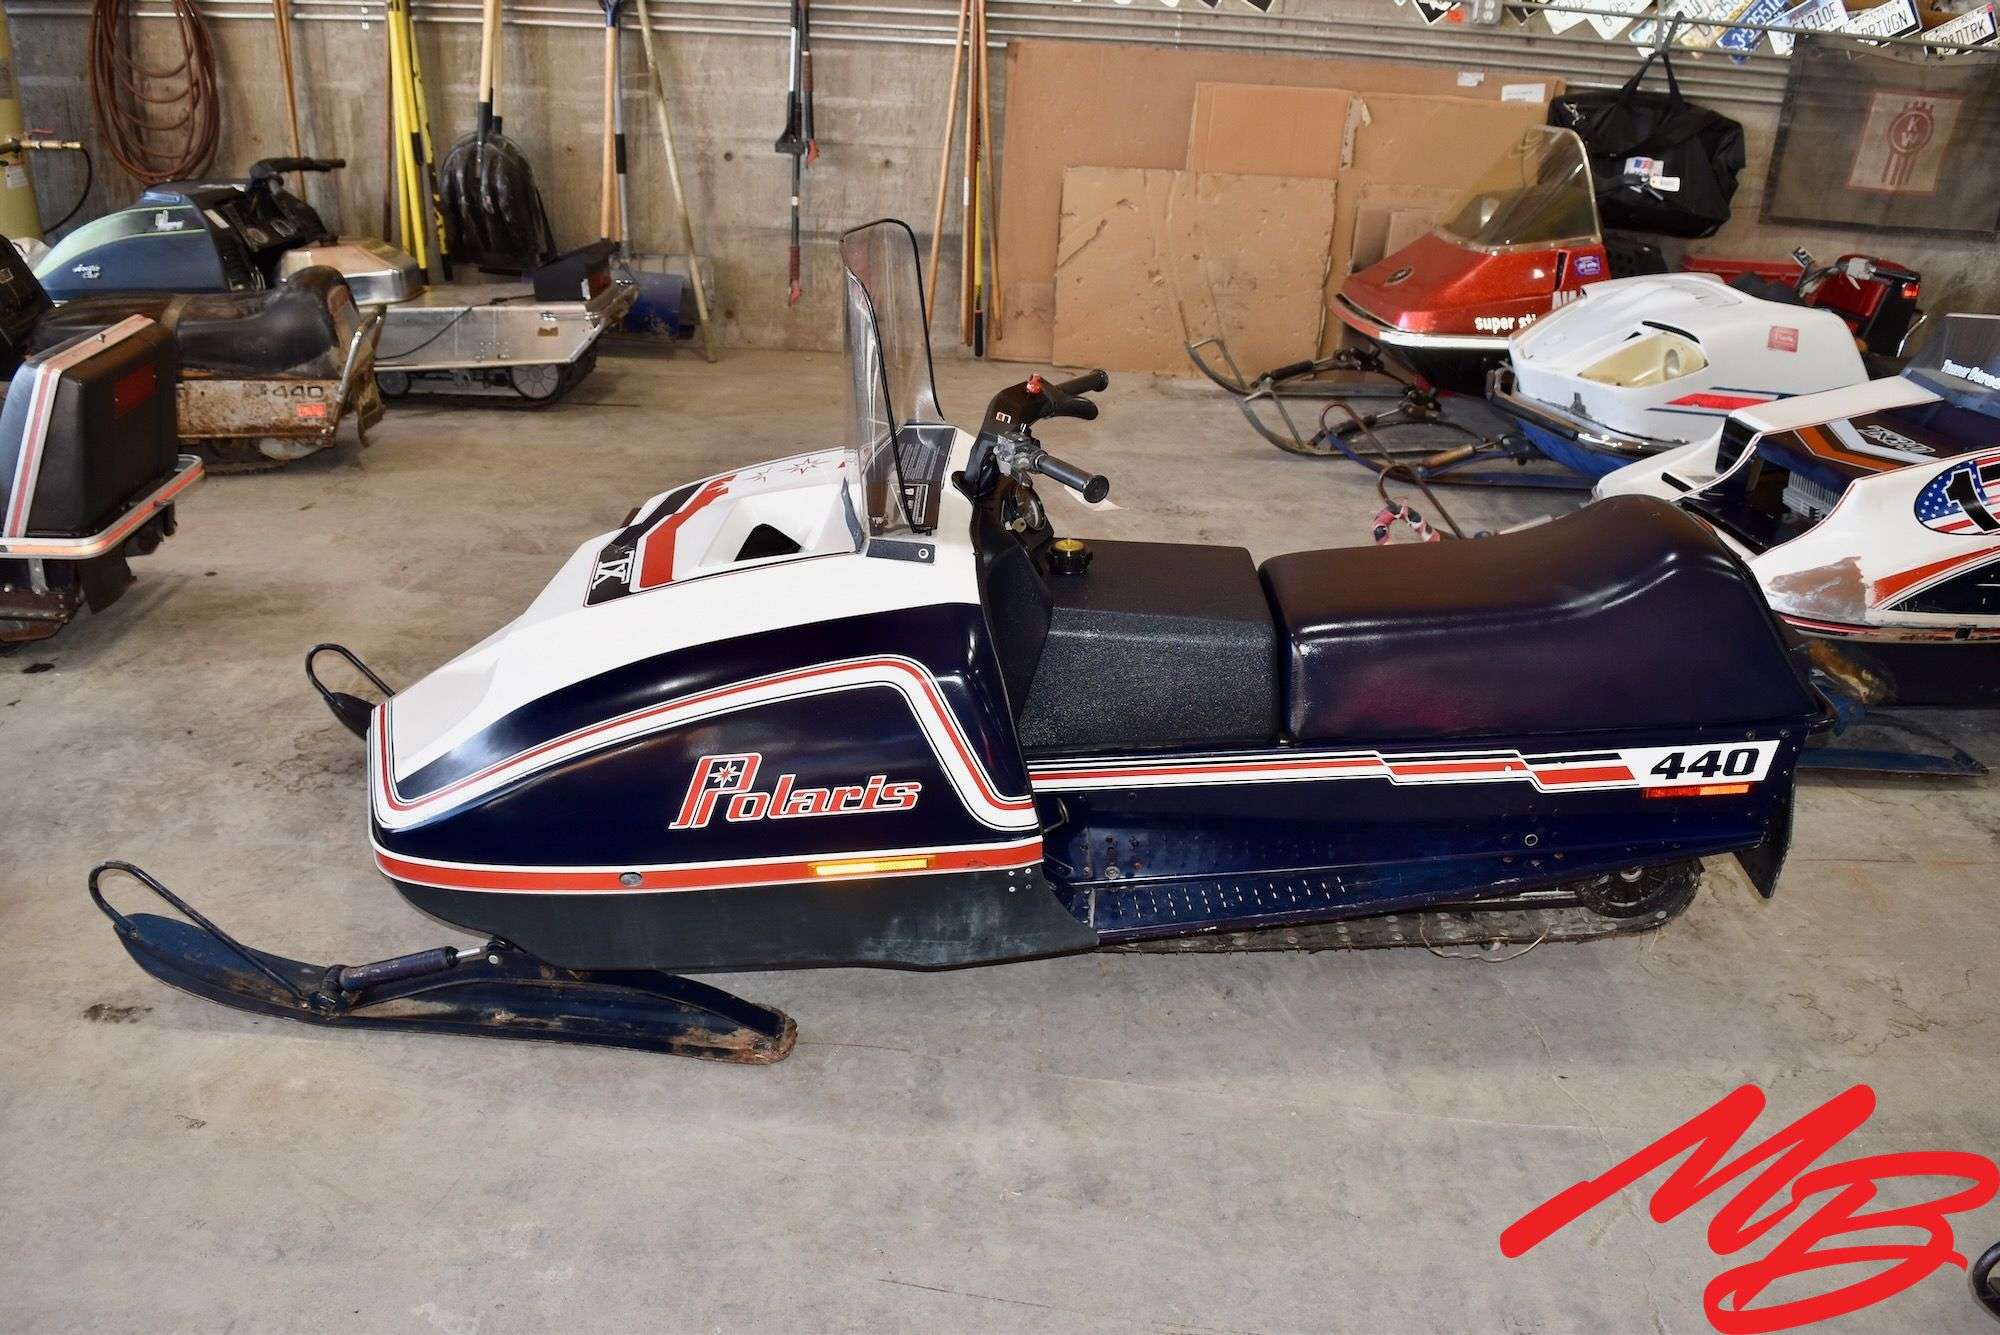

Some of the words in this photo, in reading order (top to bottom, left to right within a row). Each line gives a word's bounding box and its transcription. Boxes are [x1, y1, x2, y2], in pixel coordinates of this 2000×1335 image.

[1474, 316, 1516, 335] super
[271, 384, 324, 399] 440
[1650, 748, 1760, 780] 440
[668, 752, 922, 829] Polaris
